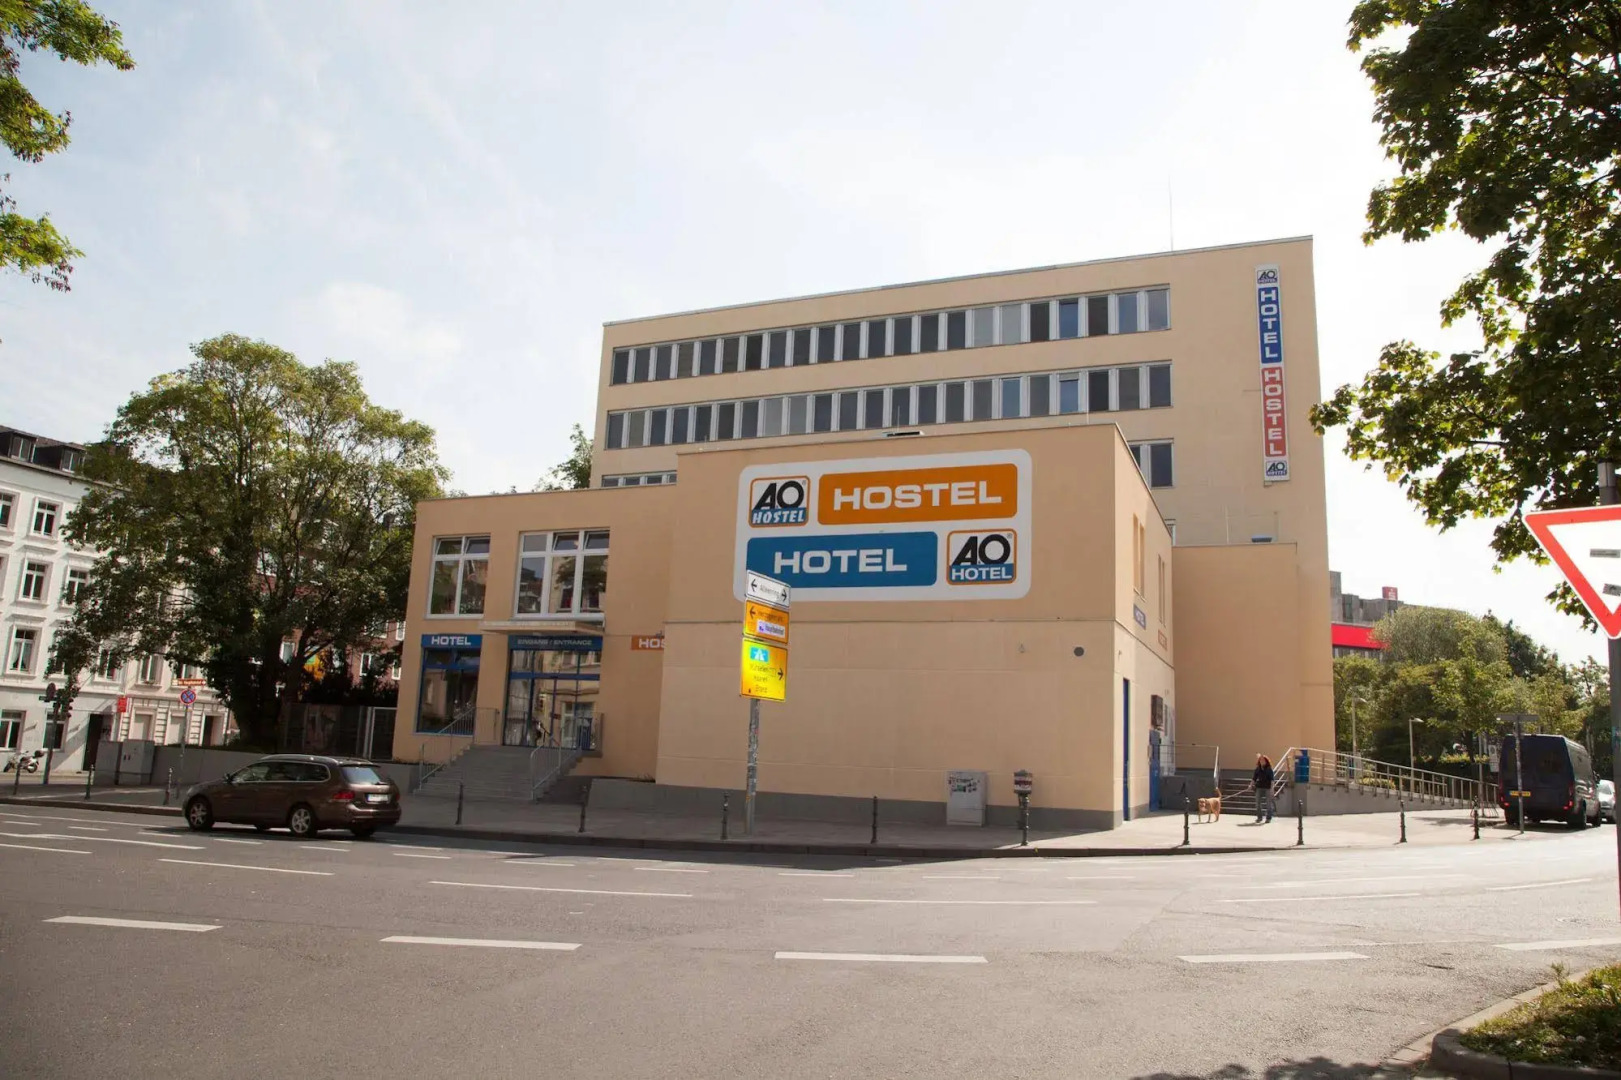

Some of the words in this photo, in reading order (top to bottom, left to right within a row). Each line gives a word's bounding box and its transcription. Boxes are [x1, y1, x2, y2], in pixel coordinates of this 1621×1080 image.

[1260, 289, 1279, 358] HOTEL
[1264, 369, 1283, 455] HOSTEL
[833, 480, 1002, 511] HOSTEL
[752, 510, 804, 524] HOSTEL
[774, 548, 908, 575] HOTEL
[951, 567, 1013, 581] HOTEL
[431, 635, 472, 646] HOTEL
